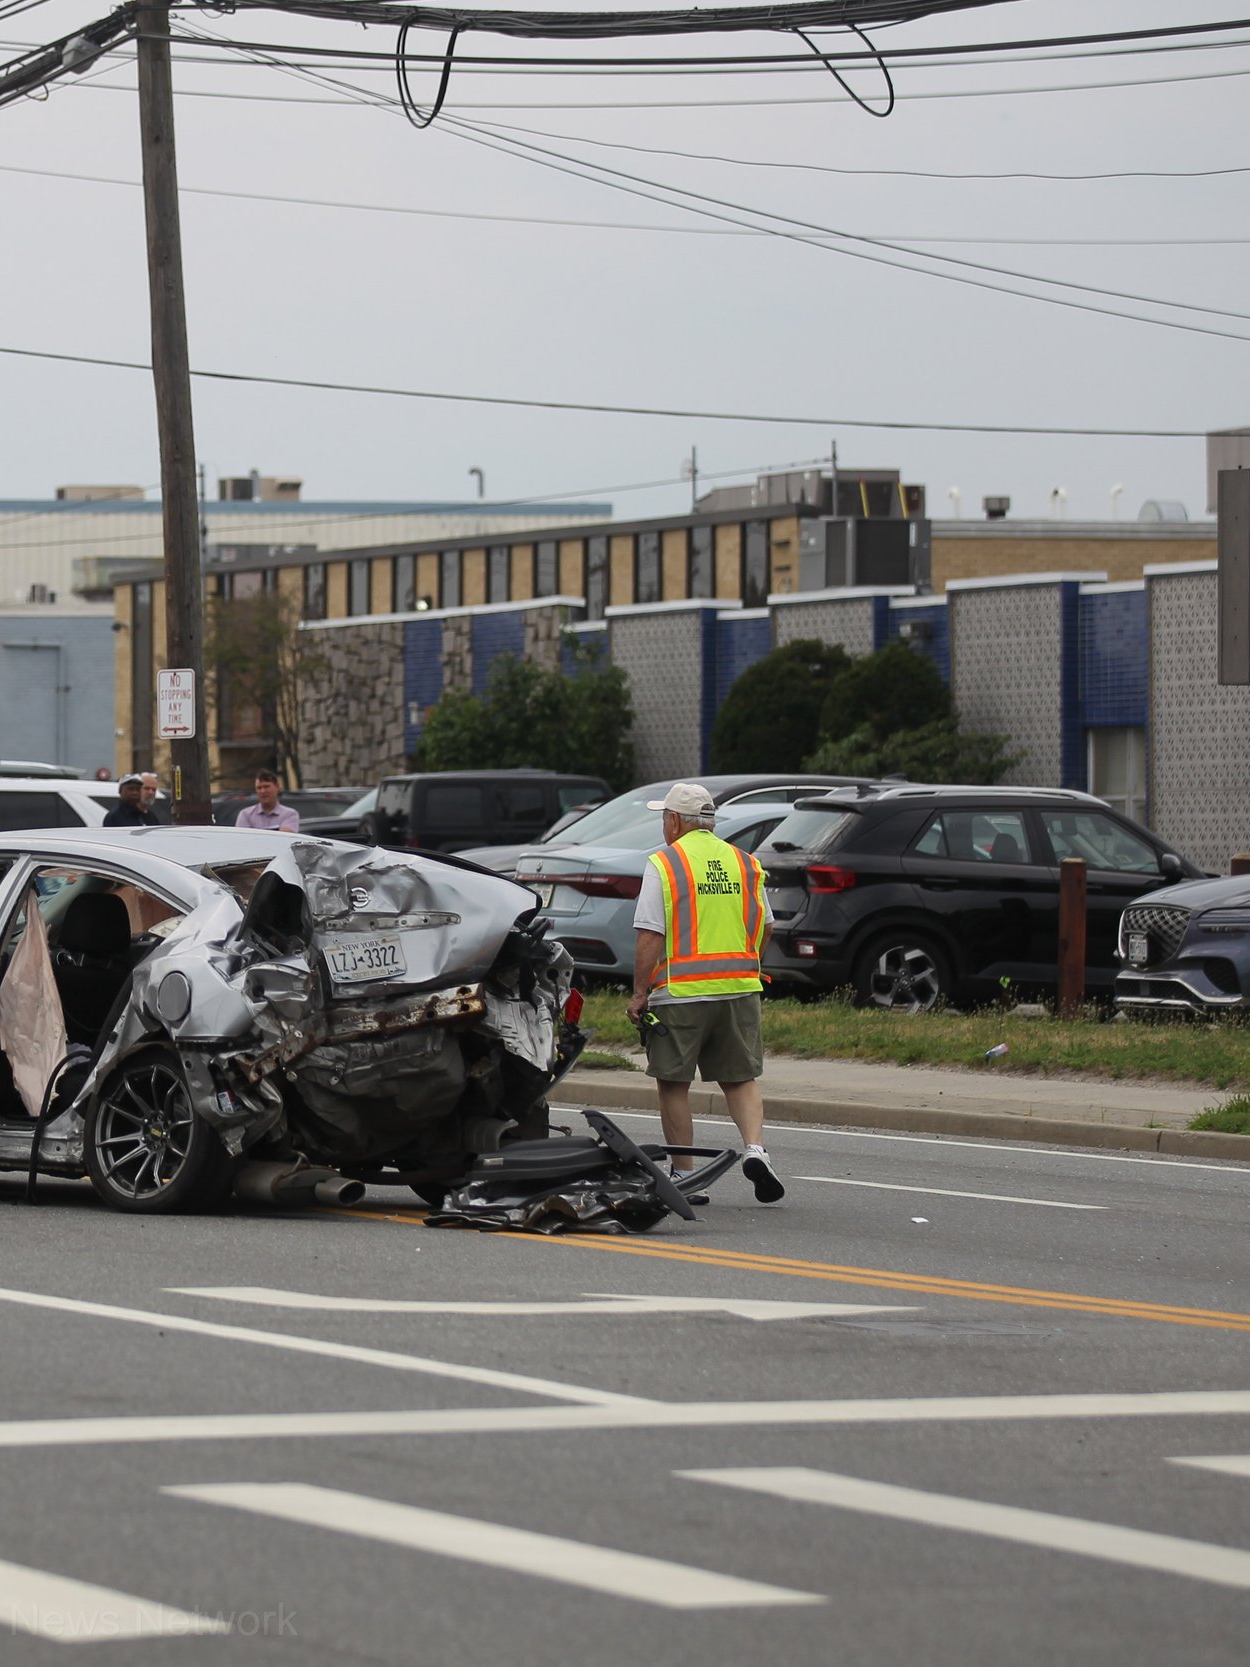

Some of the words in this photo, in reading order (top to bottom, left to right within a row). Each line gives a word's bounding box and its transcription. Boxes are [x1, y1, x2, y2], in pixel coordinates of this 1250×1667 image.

[170, 674, 181, 687] NO
[161, 689, 192, 700] STOPPING
[168, 702, 183, 712] ANY
[168, 714, 183, 724] TIME
[707, 860, 723, 871] FIRE
[705, 871, 729, 883] POLICE
[697, 882, 733, 895] HICKSVILLE
[733, 882, 741, 895] FD
[341, 943, 360, 952] NEW
[360, 940, 381, 949] YORK
